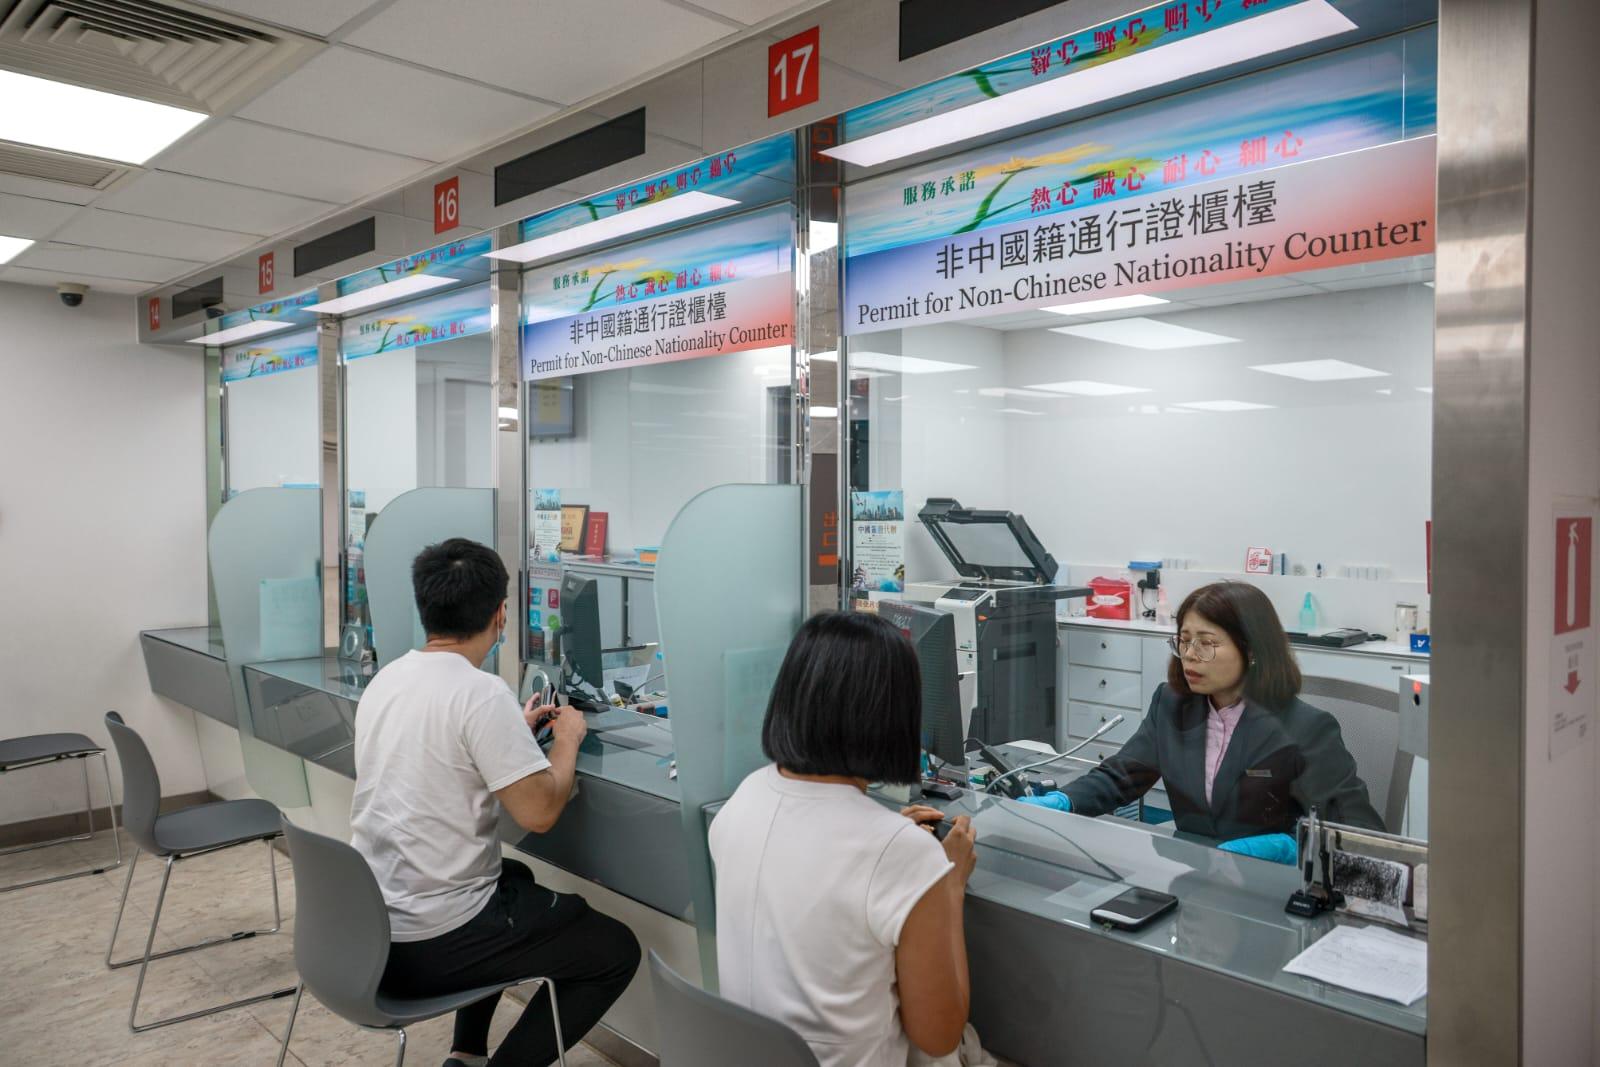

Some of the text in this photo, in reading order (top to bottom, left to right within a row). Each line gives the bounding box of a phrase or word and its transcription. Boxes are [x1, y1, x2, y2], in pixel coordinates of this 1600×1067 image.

[774, 44, 814, 101] 17
[902, 170, 976, 207] 服務承諾
[1030, 129, 1305, 213] 熱心 誠心 耐心 細心
[437, 189, 457, 223] 16
[936, 180, 1278, 281] 非中國籍通行證櫃檯
[261, 260, 273, 287] 15
[858, 216, 1428, 326] Permit for Non-Chinese Nationality Counter
[569, 291, 727, 345] 非中國籍通行證櫃檯
[530, 323, 788, 374] Permit for Non-Chinese Nationality Counter
